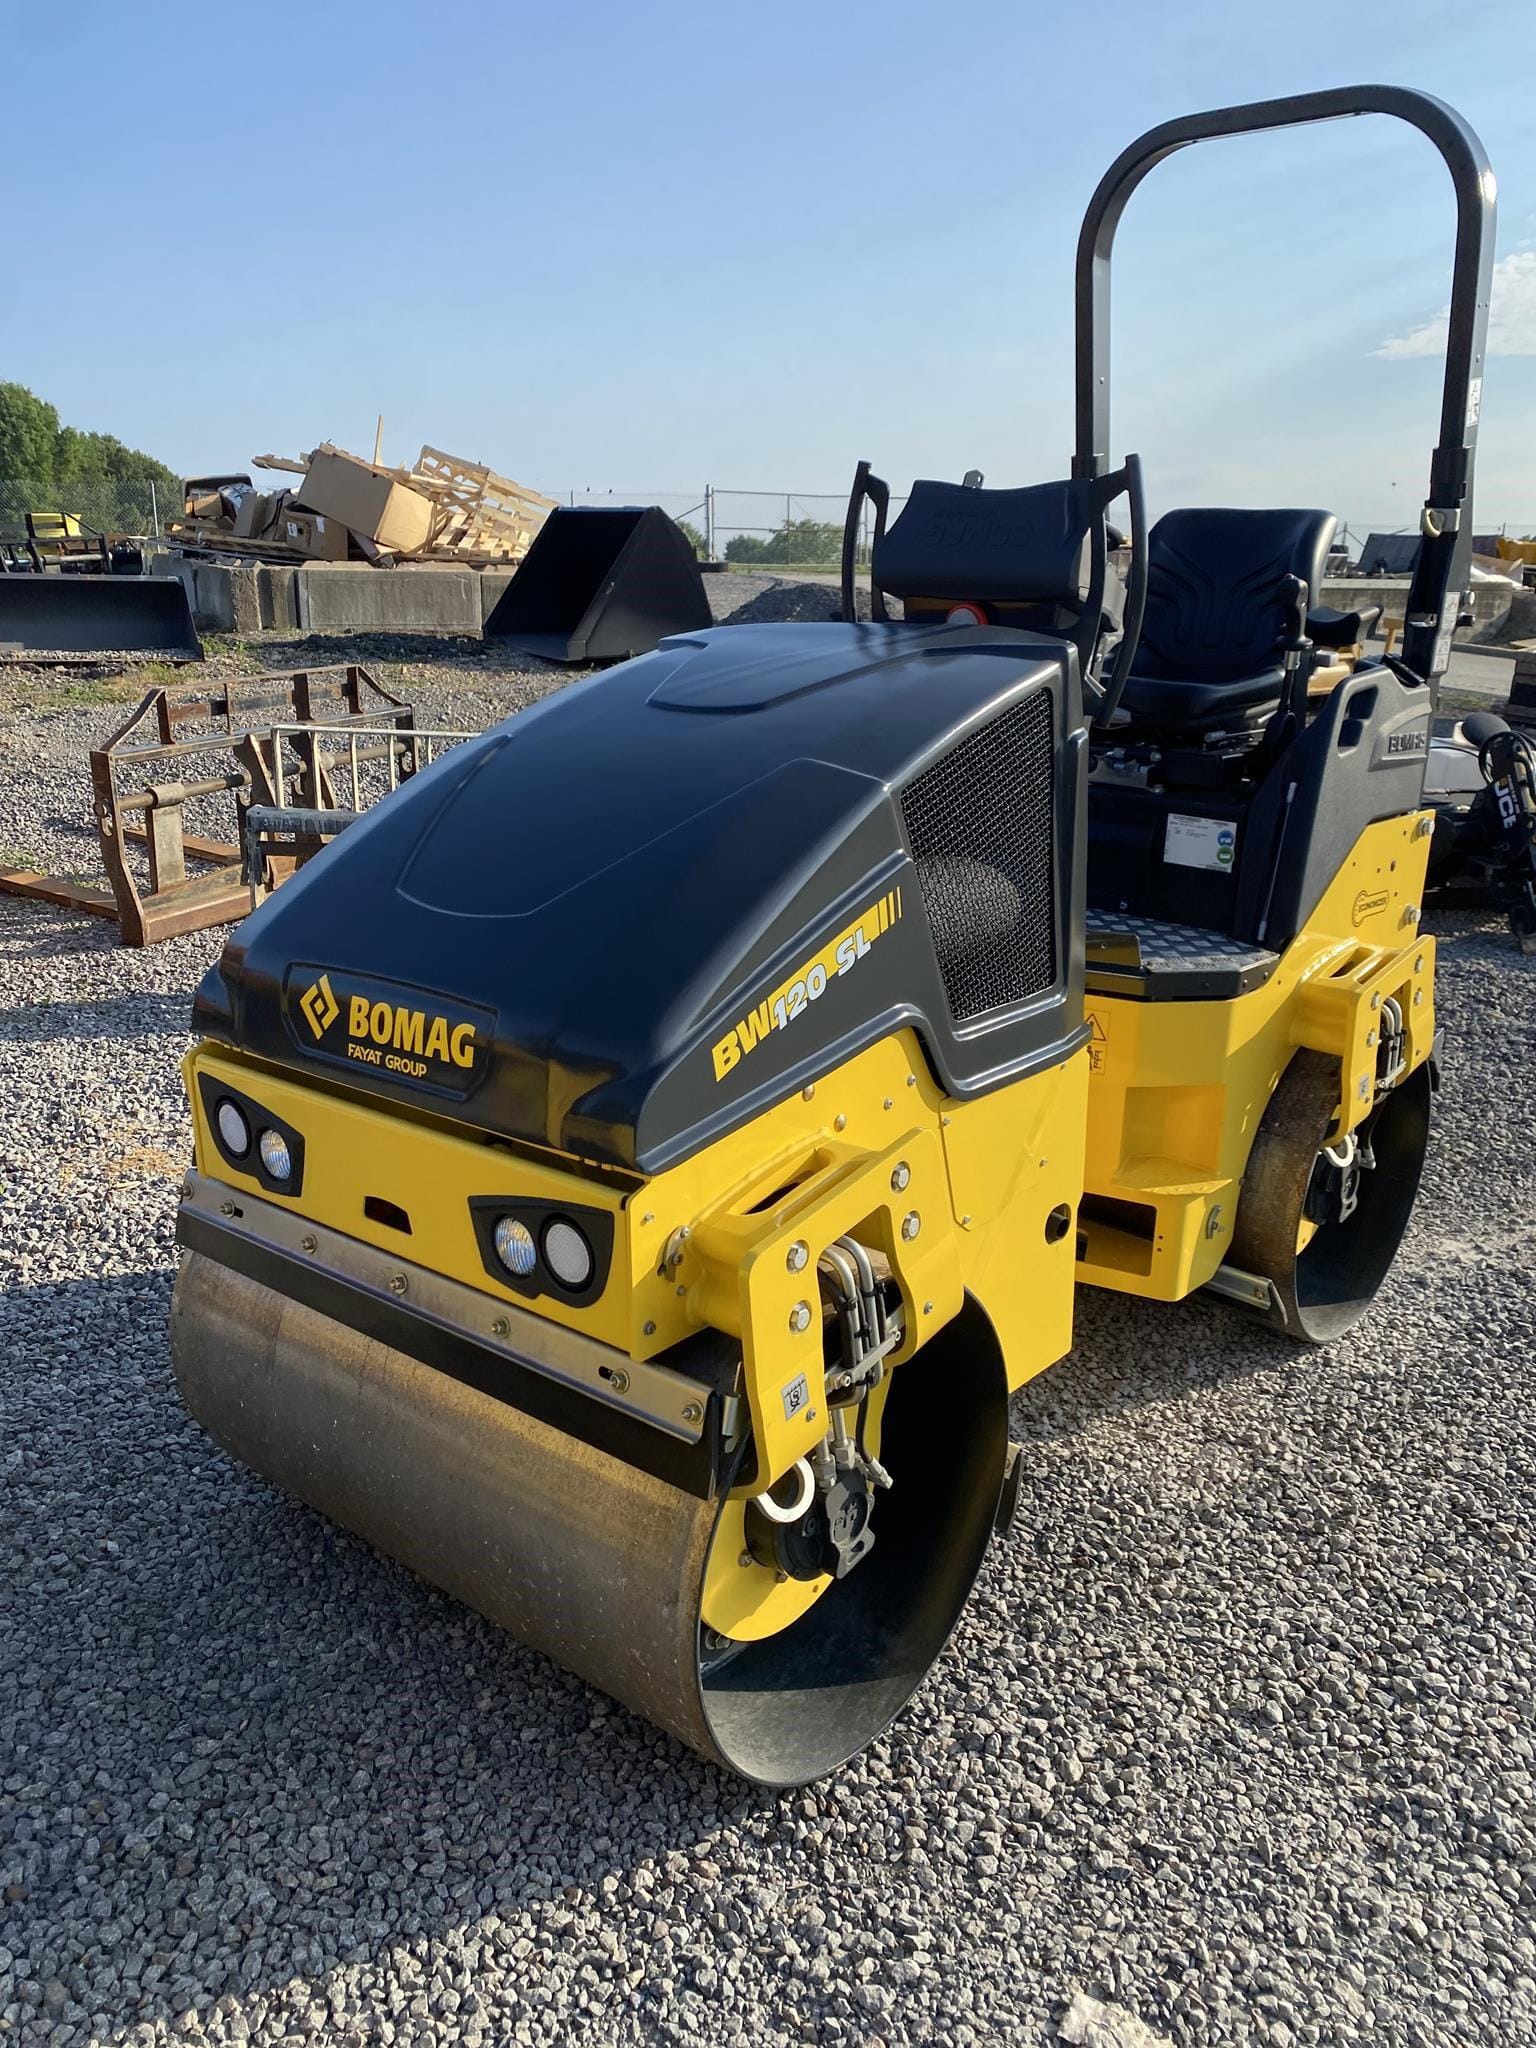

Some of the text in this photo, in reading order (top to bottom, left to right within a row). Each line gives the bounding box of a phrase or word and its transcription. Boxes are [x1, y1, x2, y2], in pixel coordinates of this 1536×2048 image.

[835, 926, 872, 977] SL
[348, 995, 477, 1068] BOMAG
[347, 1043, 428, 1078] FAYAT GROUP
